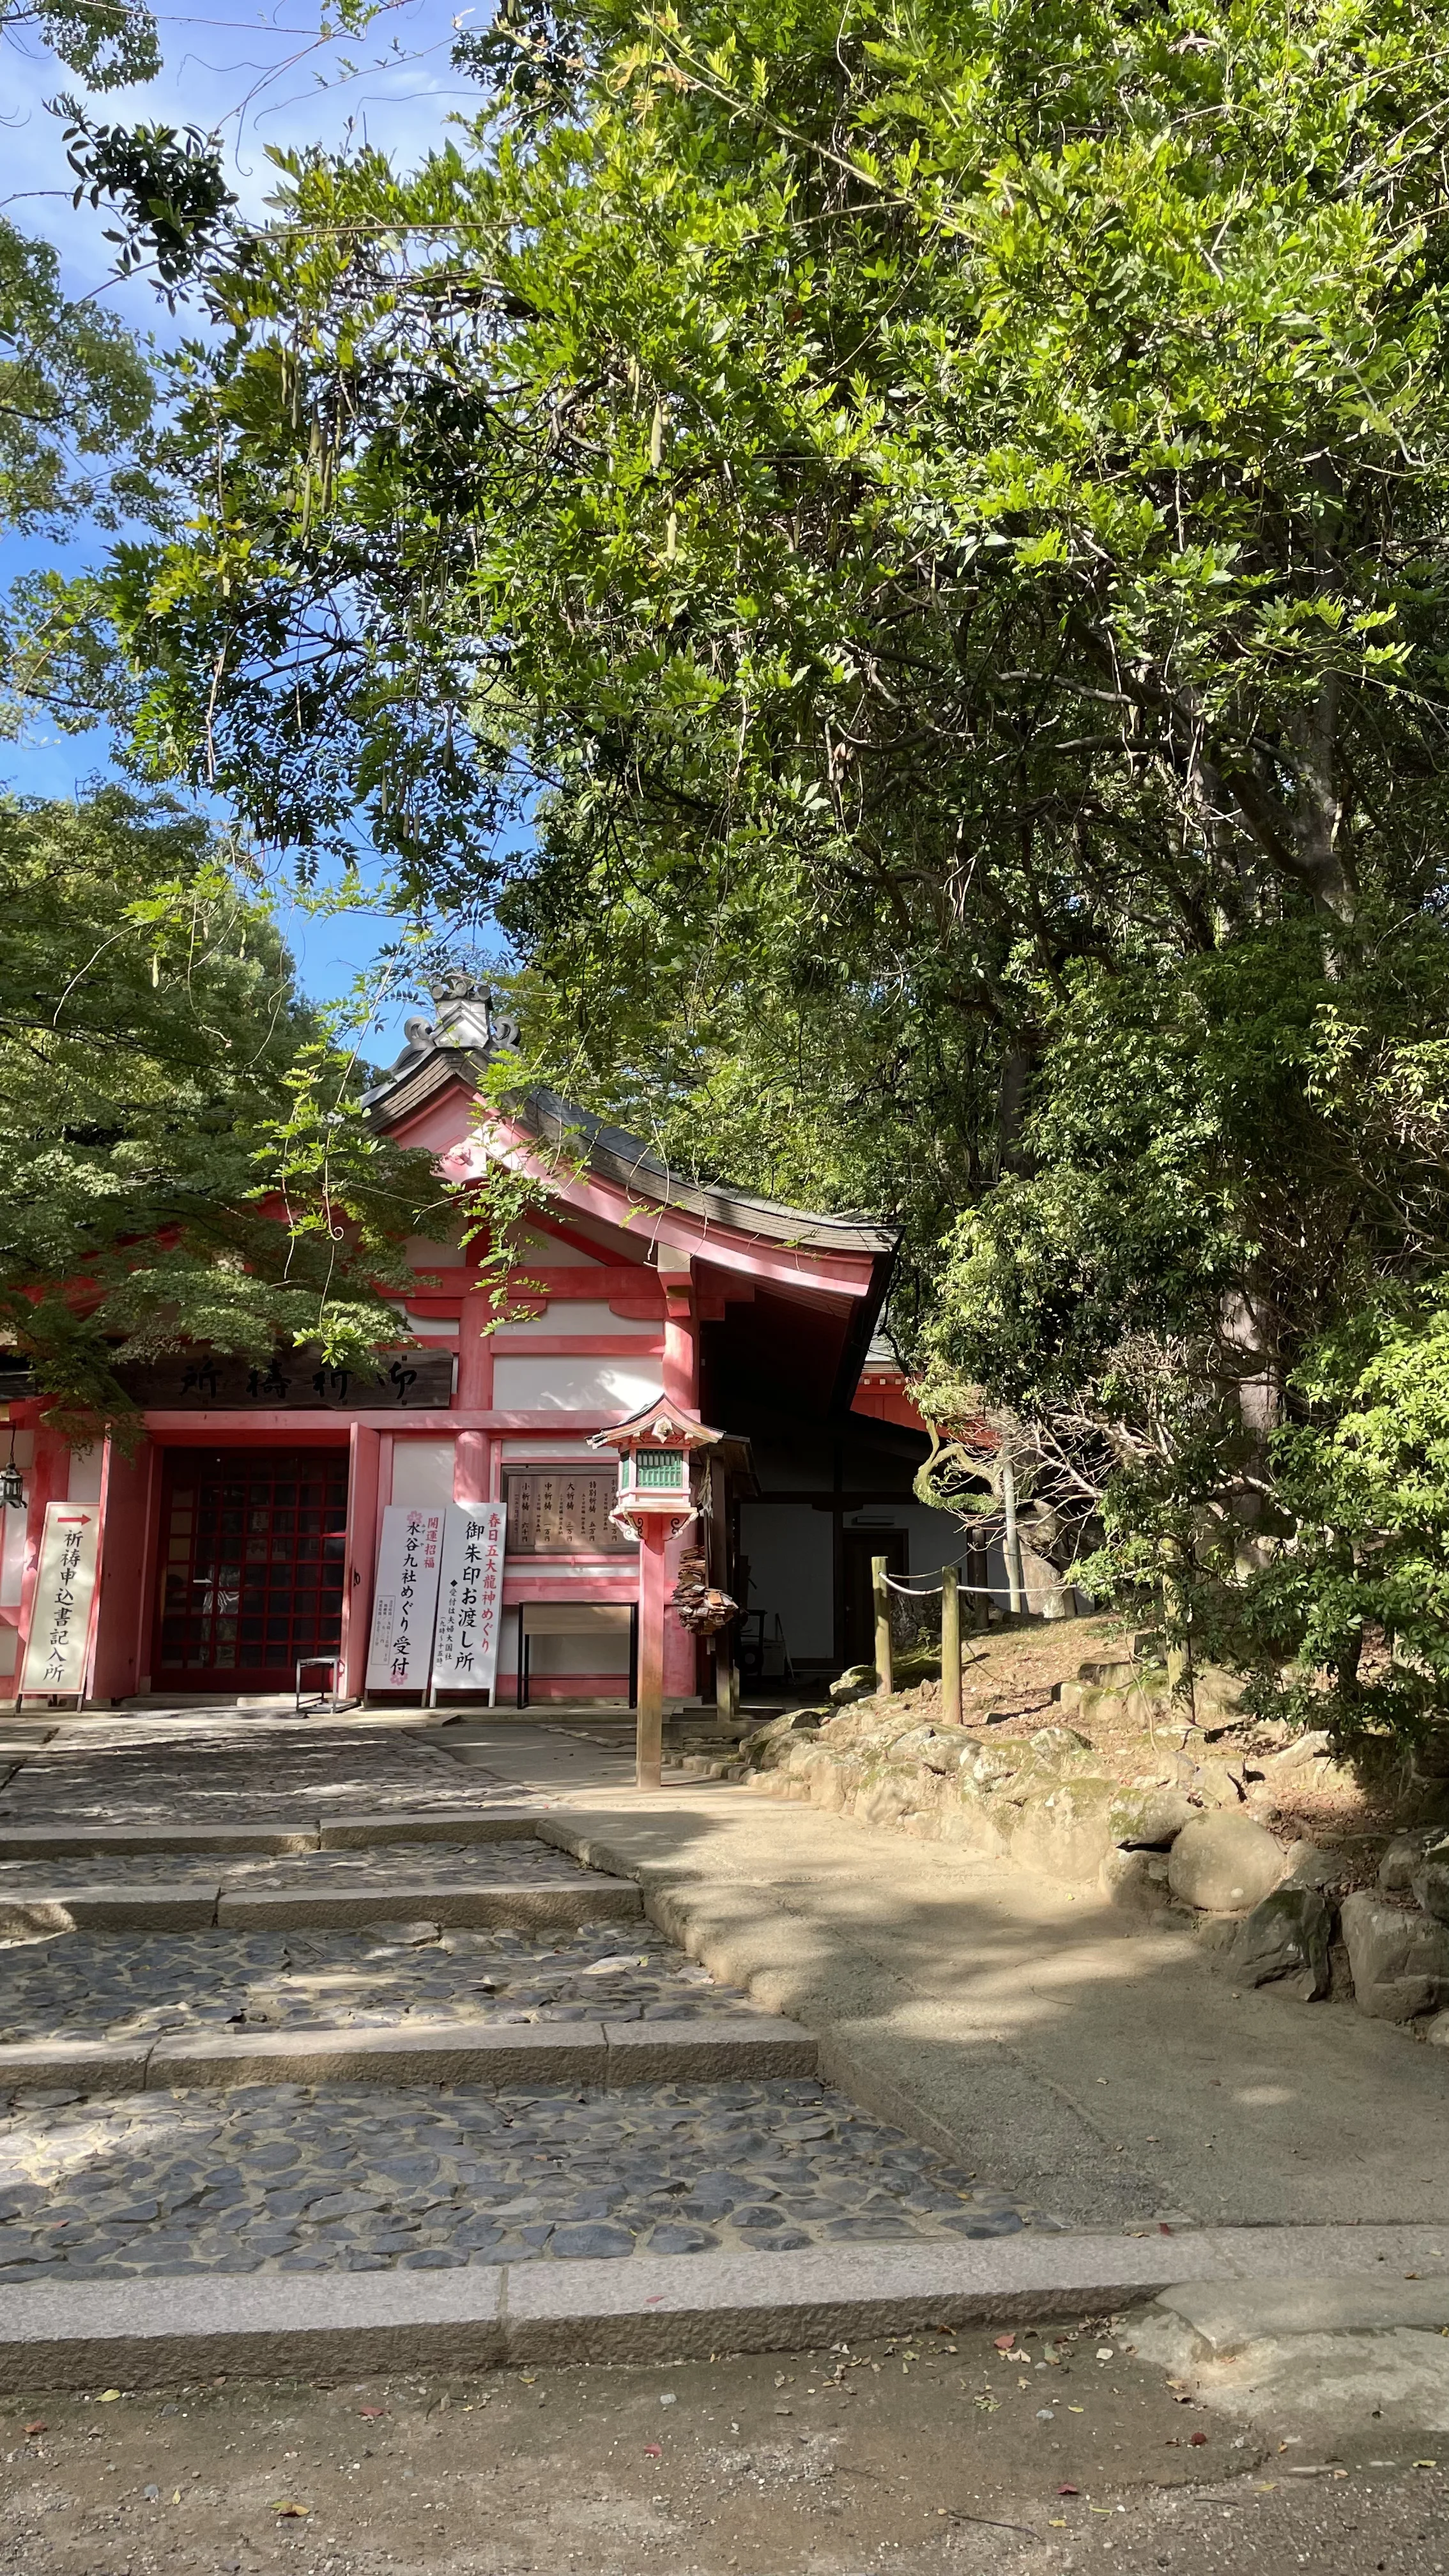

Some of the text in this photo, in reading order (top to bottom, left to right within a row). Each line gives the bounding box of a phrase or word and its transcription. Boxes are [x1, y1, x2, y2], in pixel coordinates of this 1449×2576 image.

[42, 1529, 83, 1683] 祈祷申込書記入所
[390, 1522, 420, 1675] 水谷九社めぐり受付
[424, 1517, 439, 1568] 開運招福
[455, 1521, 484, 1671] 御朱印お渡し所
[481, 1512, 501, 1654] 春日五大龍神めぐり
